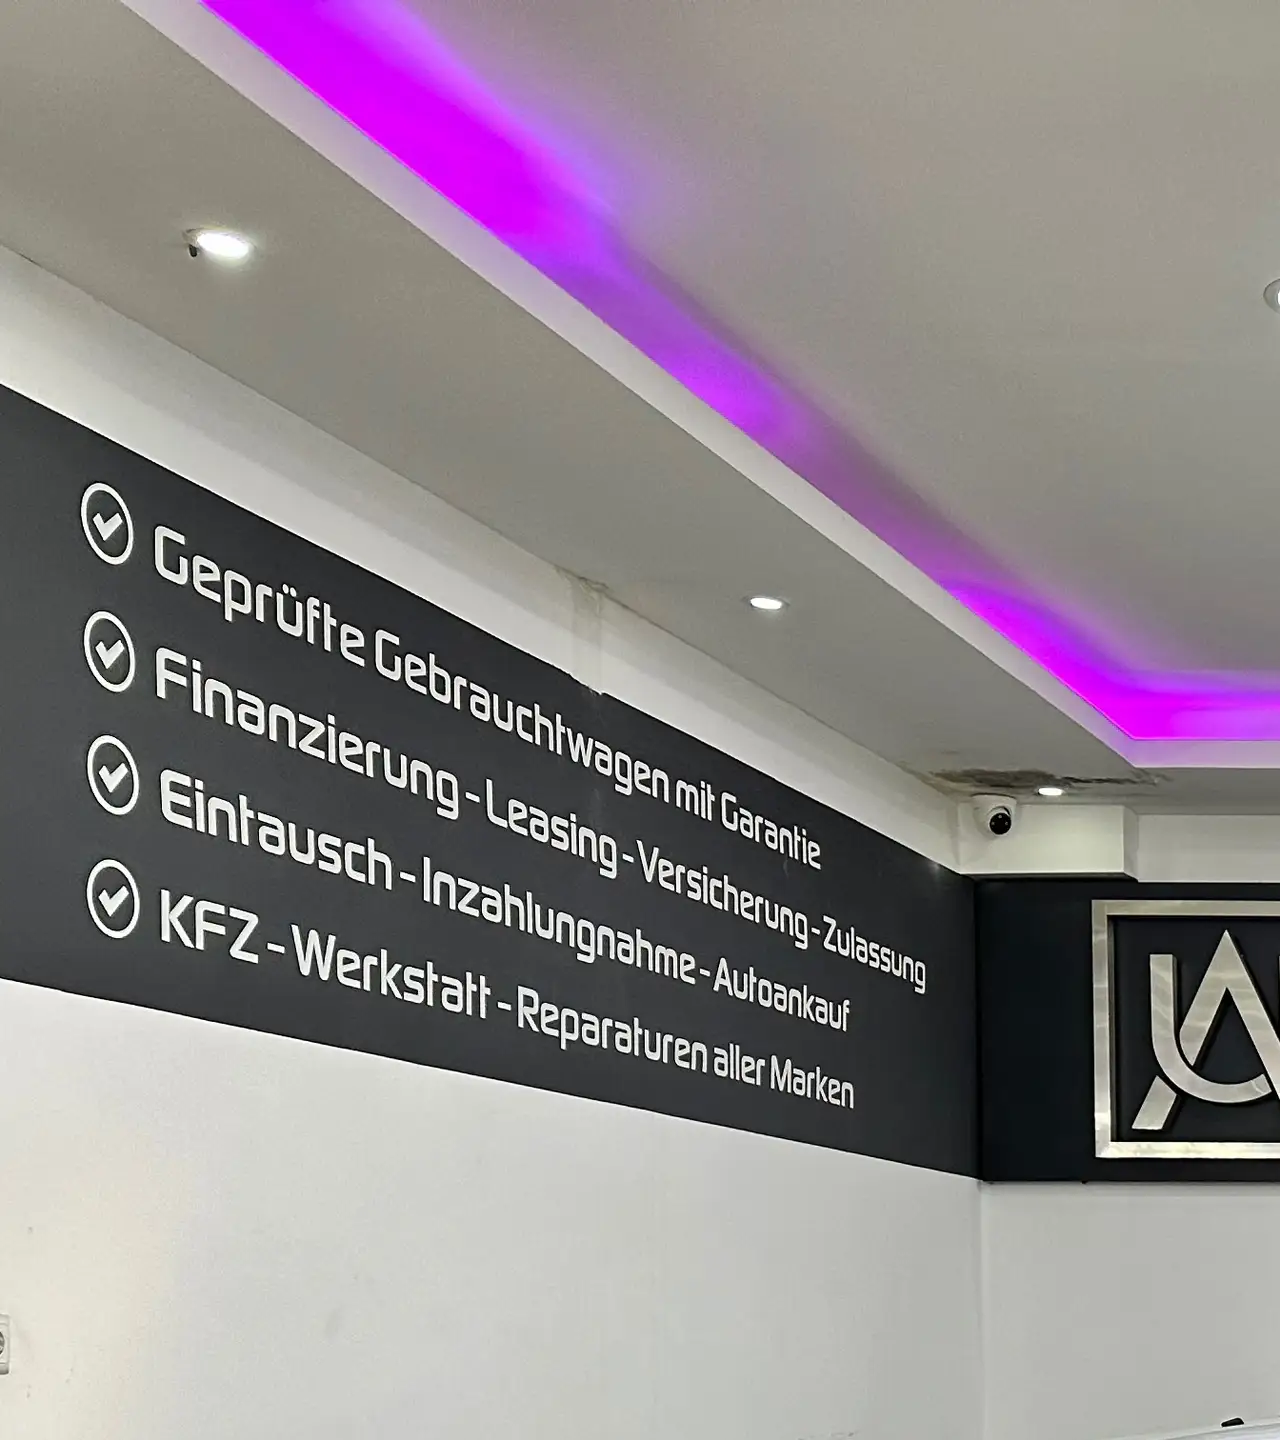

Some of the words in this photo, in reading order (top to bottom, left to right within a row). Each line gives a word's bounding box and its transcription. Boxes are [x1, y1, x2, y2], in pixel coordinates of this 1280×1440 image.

[155, 526, 365, 667] Geprüfte
[376, 630, 669, 803] Gebrauchtwagen
[676, 780, 715, 821] mit
[722, 793, 821, 869] Garantie
[156, 648, 459, 820] Finanzierung
[486, 779, 617, 879] Leasing
[637, 840, 808, 949] Versicherung
[824, 916, 926, 994] Zulassung
[161, 770, 392, 891] Eintausch
[424, 857, 695, 984] Inzahlungnahme
[713, 958, 850, 1031] Autoankauf
[161, 890, 258, 964] KFZ
[291, 925, 492, 1019] Werkstatt
[518, 986, 708, 1073] Reparaturen
[714, 1044, 766, 1086] aller
[771, 1055, 853, 1108] Marken
